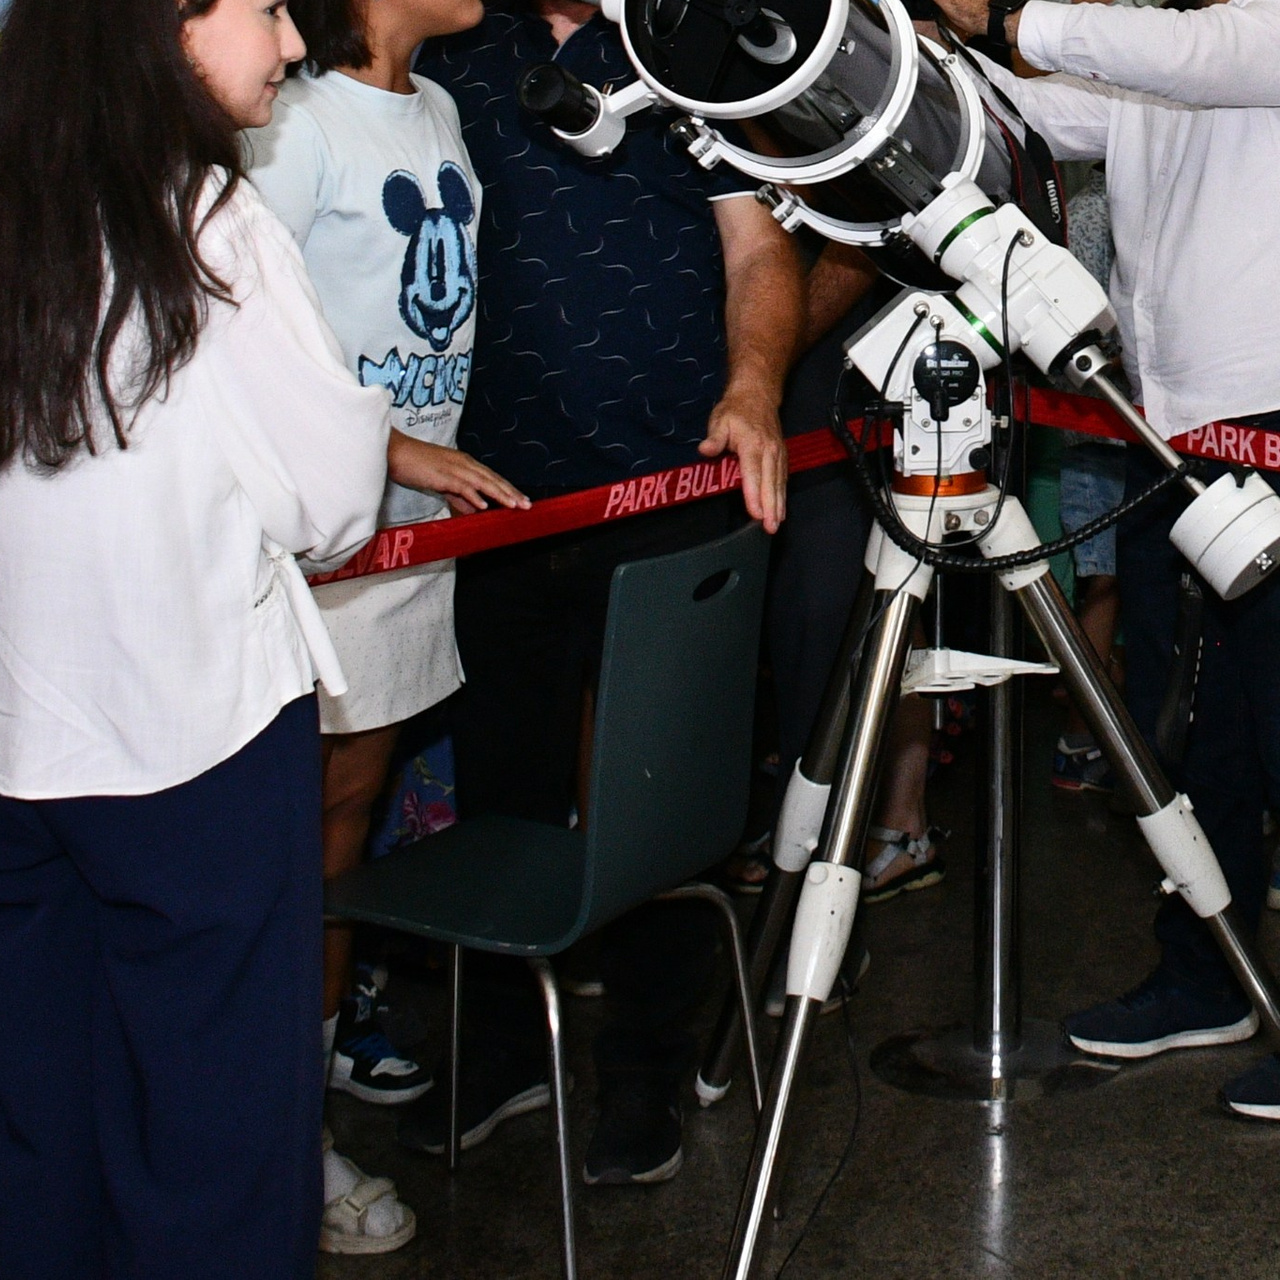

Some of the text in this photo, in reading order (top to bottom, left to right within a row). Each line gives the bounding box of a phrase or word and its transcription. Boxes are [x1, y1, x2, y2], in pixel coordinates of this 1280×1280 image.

[1045, 179, 1061, 224] Canon
[358, 344, 472, 408] MICKE
[1187, 423, 1256, 464] PARK
[604, 457, 743, 518] PARK BULVA
